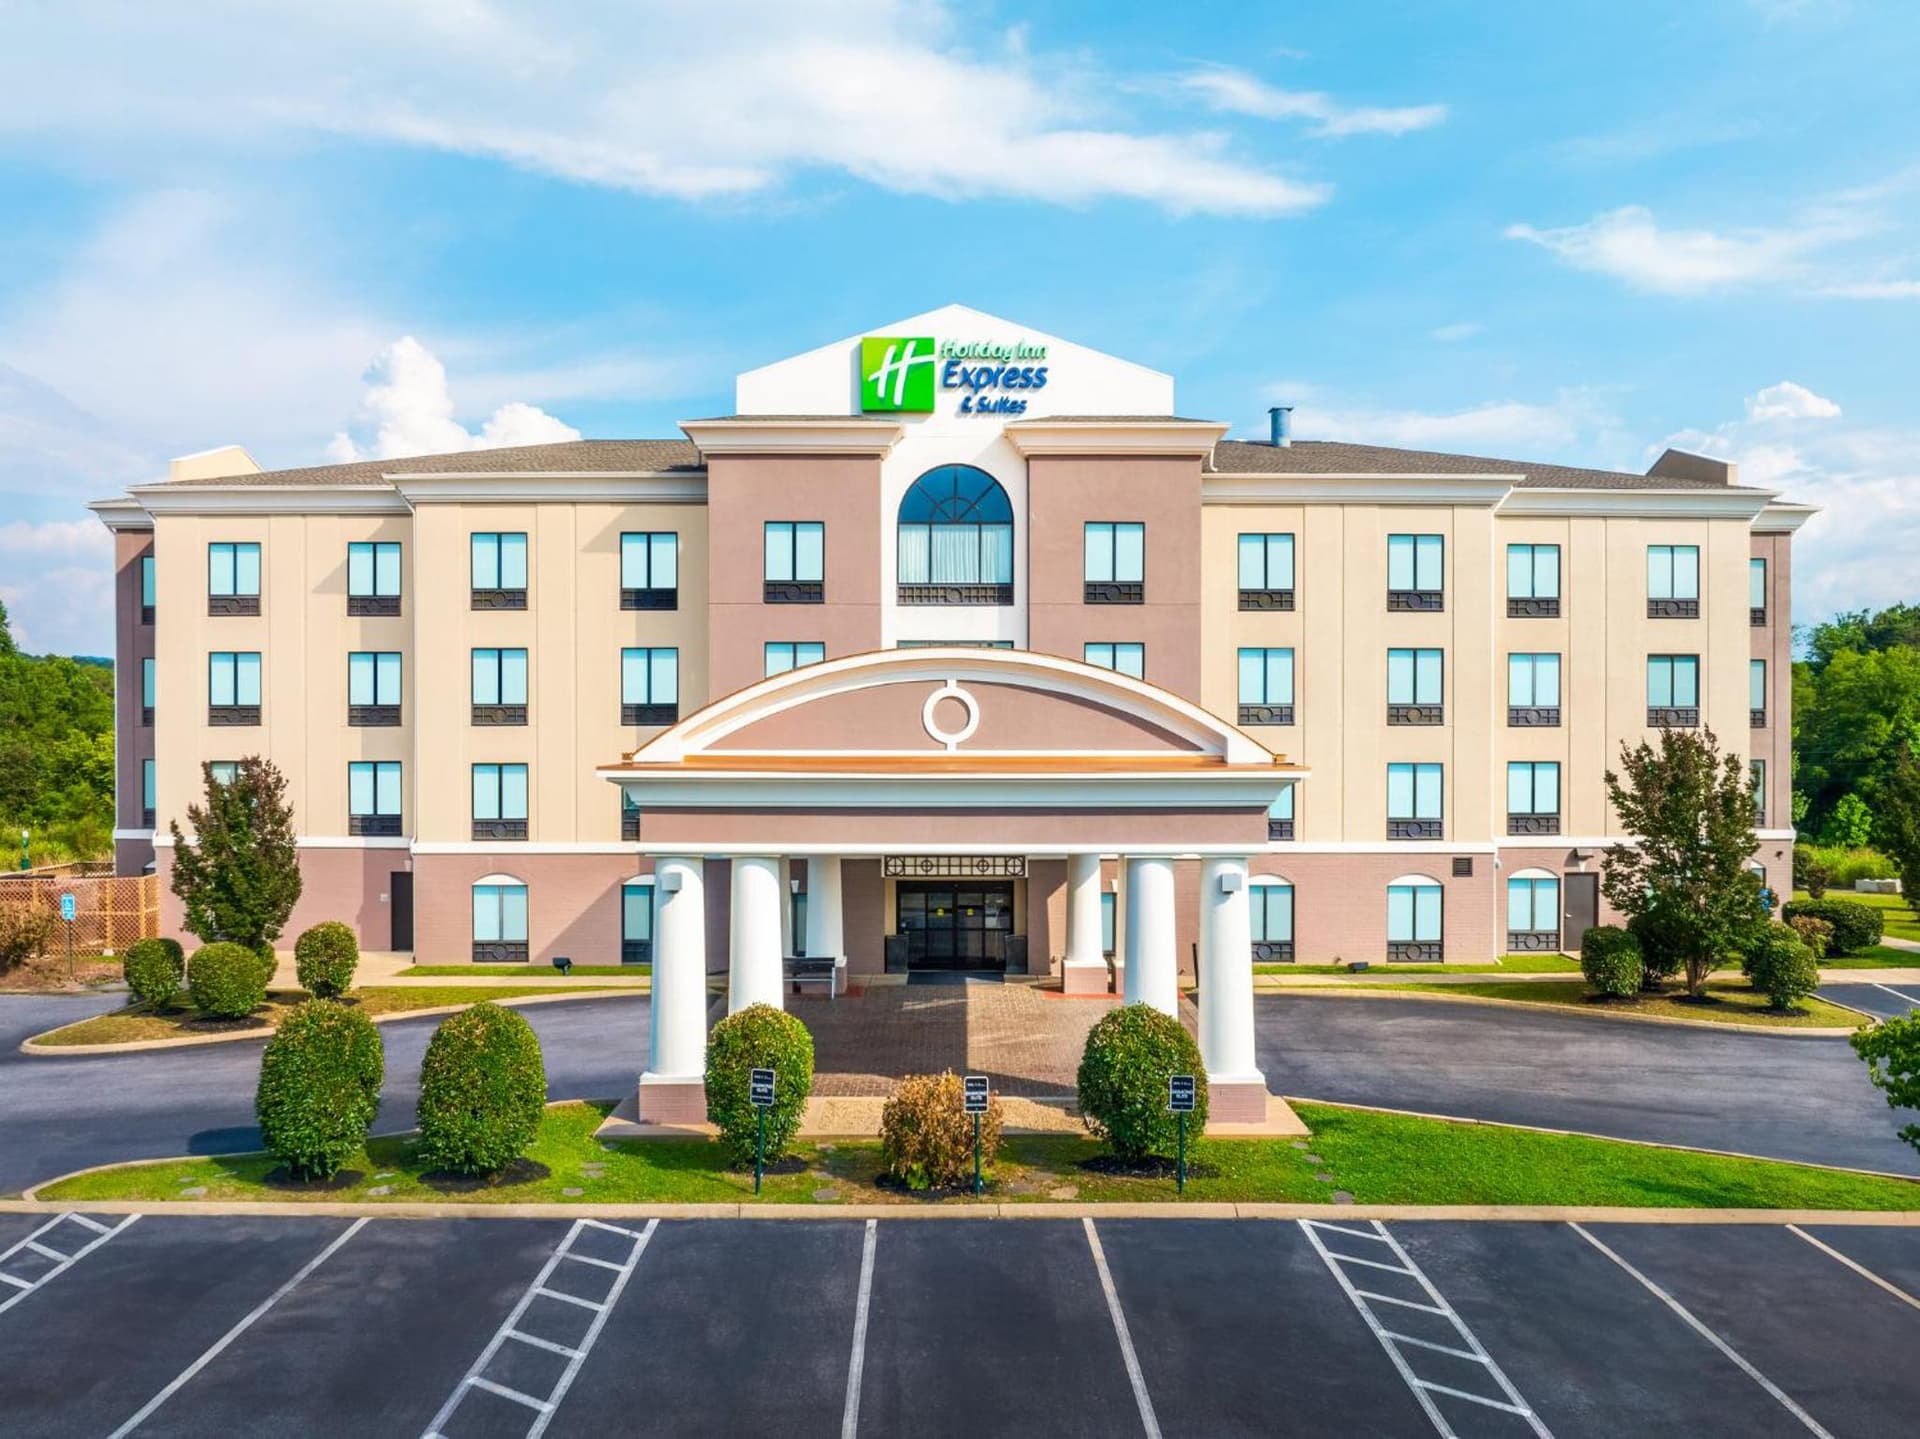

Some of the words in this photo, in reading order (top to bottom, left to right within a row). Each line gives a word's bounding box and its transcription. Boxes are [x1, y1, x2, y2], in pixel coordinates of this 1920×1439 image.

[940, 340, 1012, 363] Holiday
[1017, 341, 1047, 359] Inn
[942, 359, 1048, 395] Express
[960, 396, 972, 414] &
[975, 396, 1028, 414] Suites
